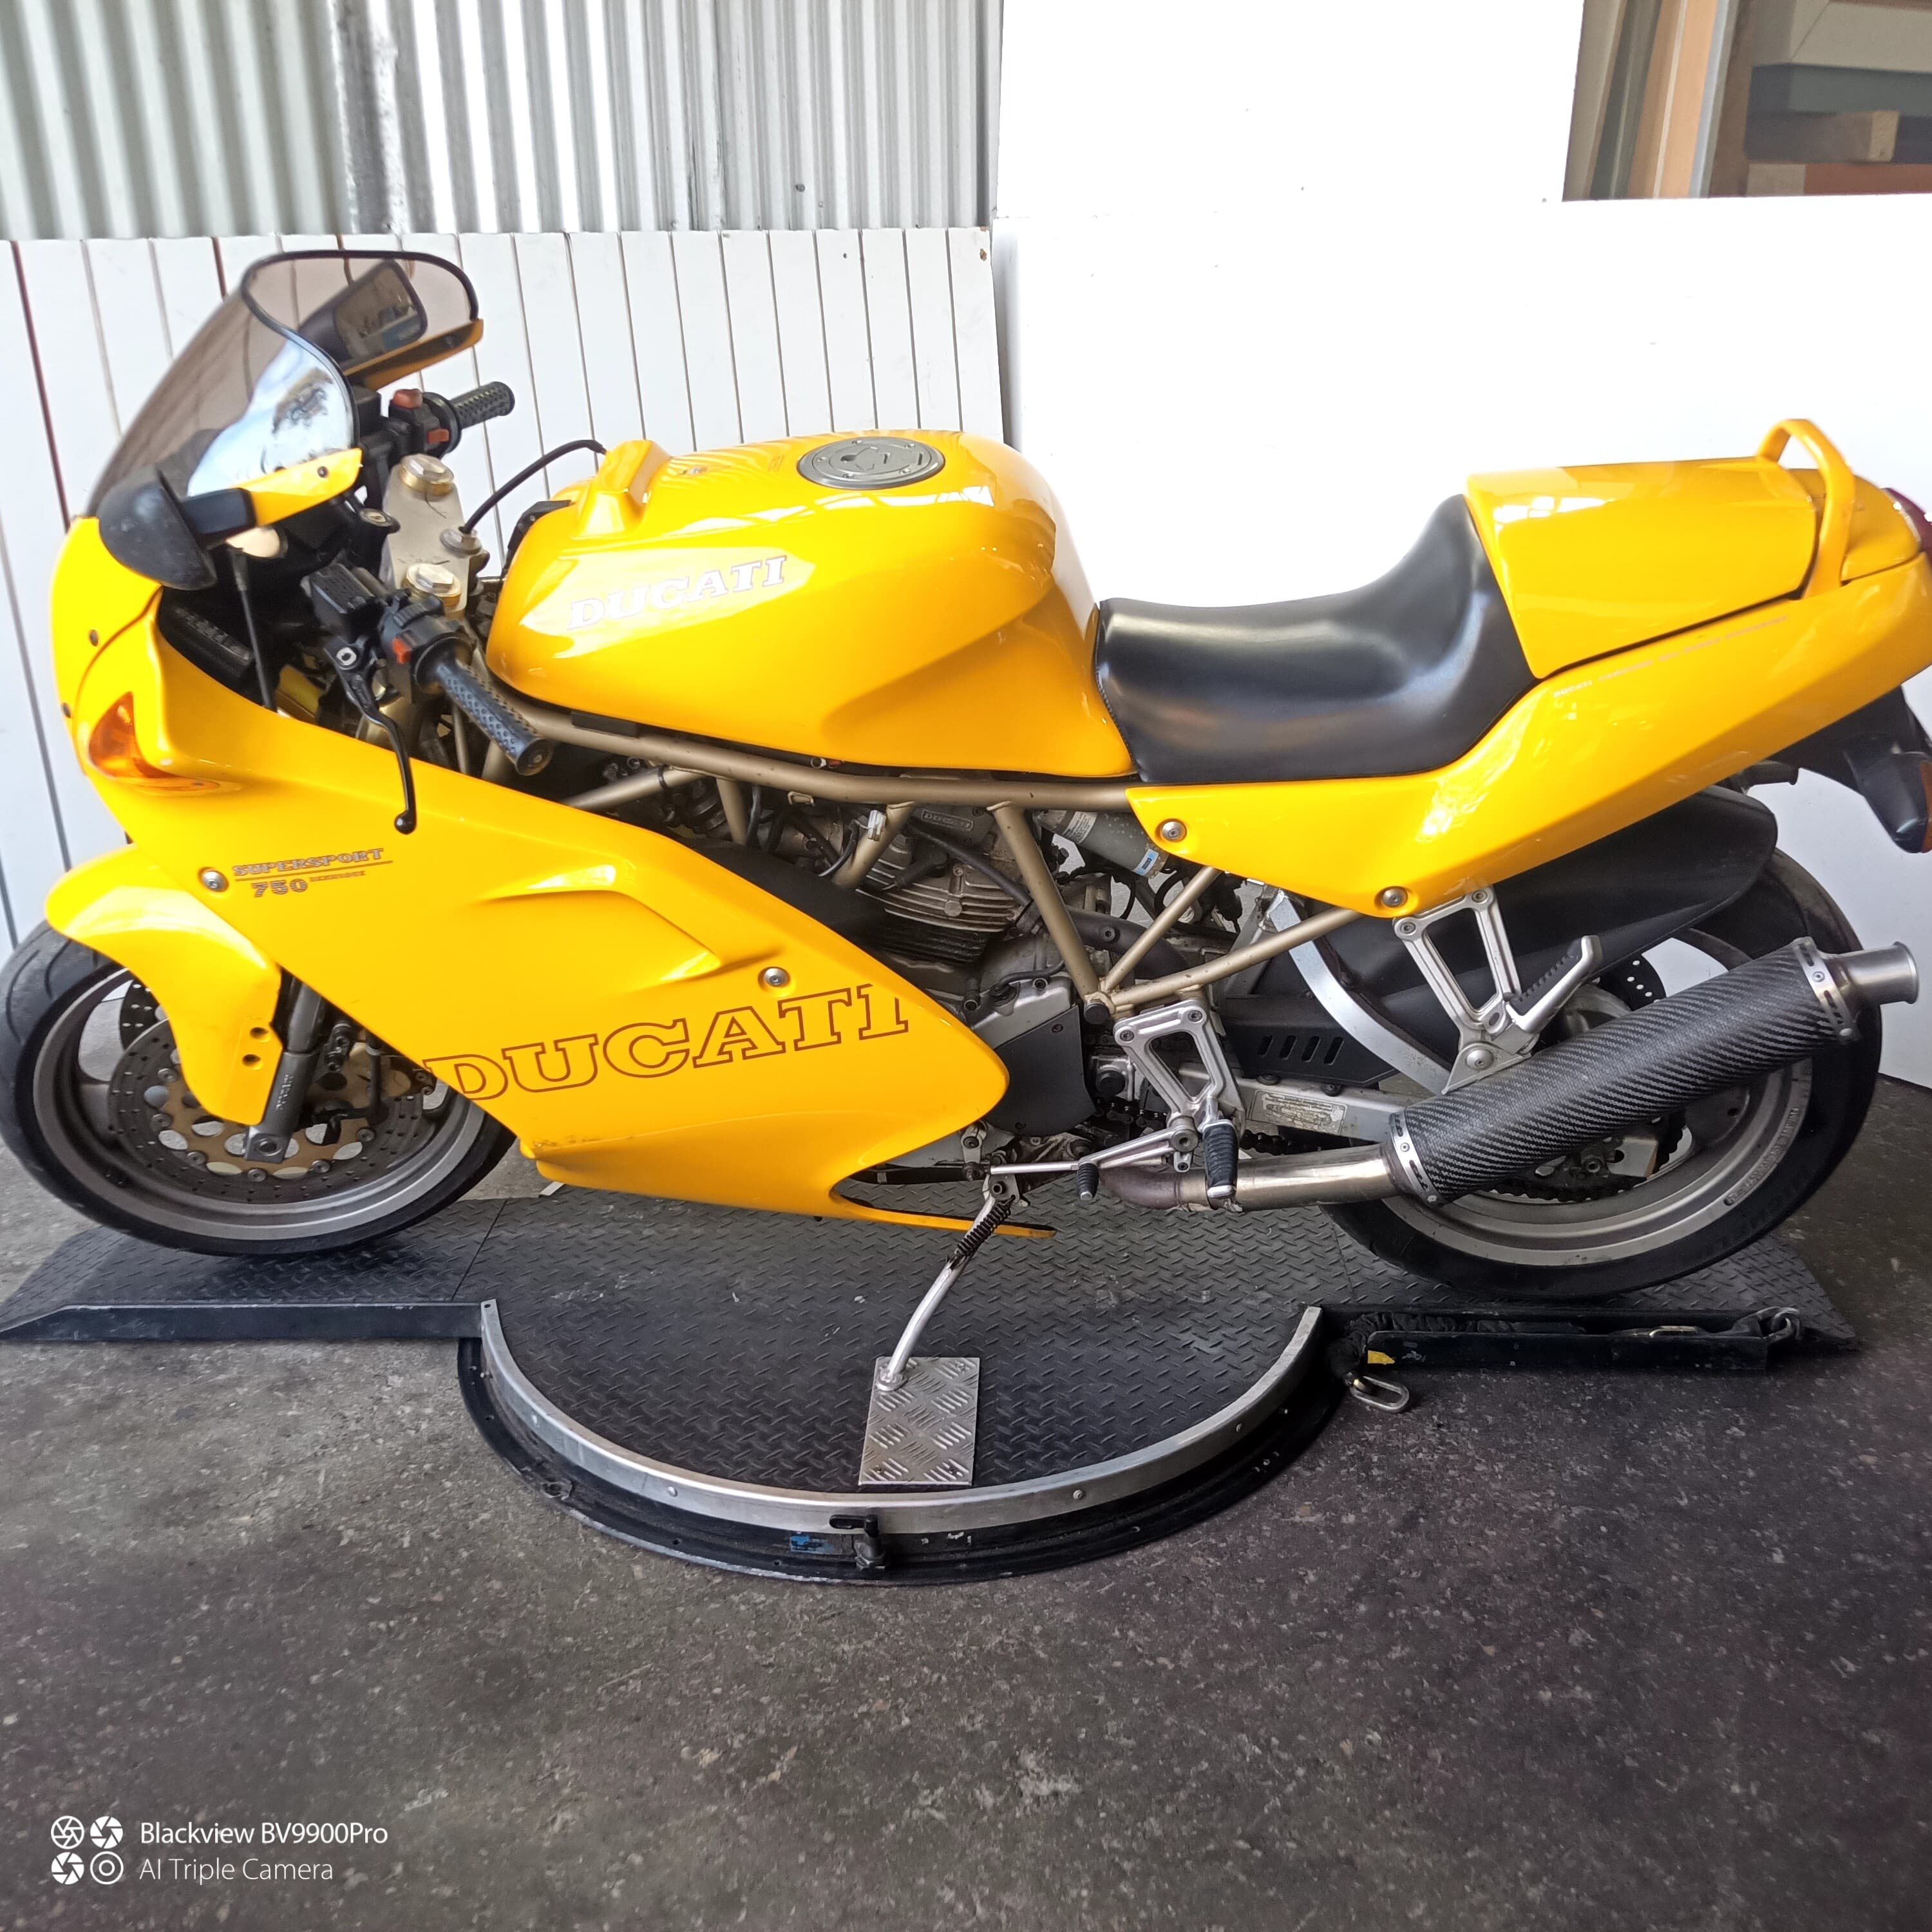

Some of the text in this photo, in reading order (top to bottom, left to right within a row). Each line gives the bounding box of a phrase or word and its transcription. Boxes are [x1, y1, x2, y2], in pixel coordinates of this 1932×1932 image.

[567, 555, 787, 631] DUCATI
[232, 848, 384, 876] SUPERSPORT
[251, 878, 308, 898] 750
[422, 983, 909, 1101] DUCATI
